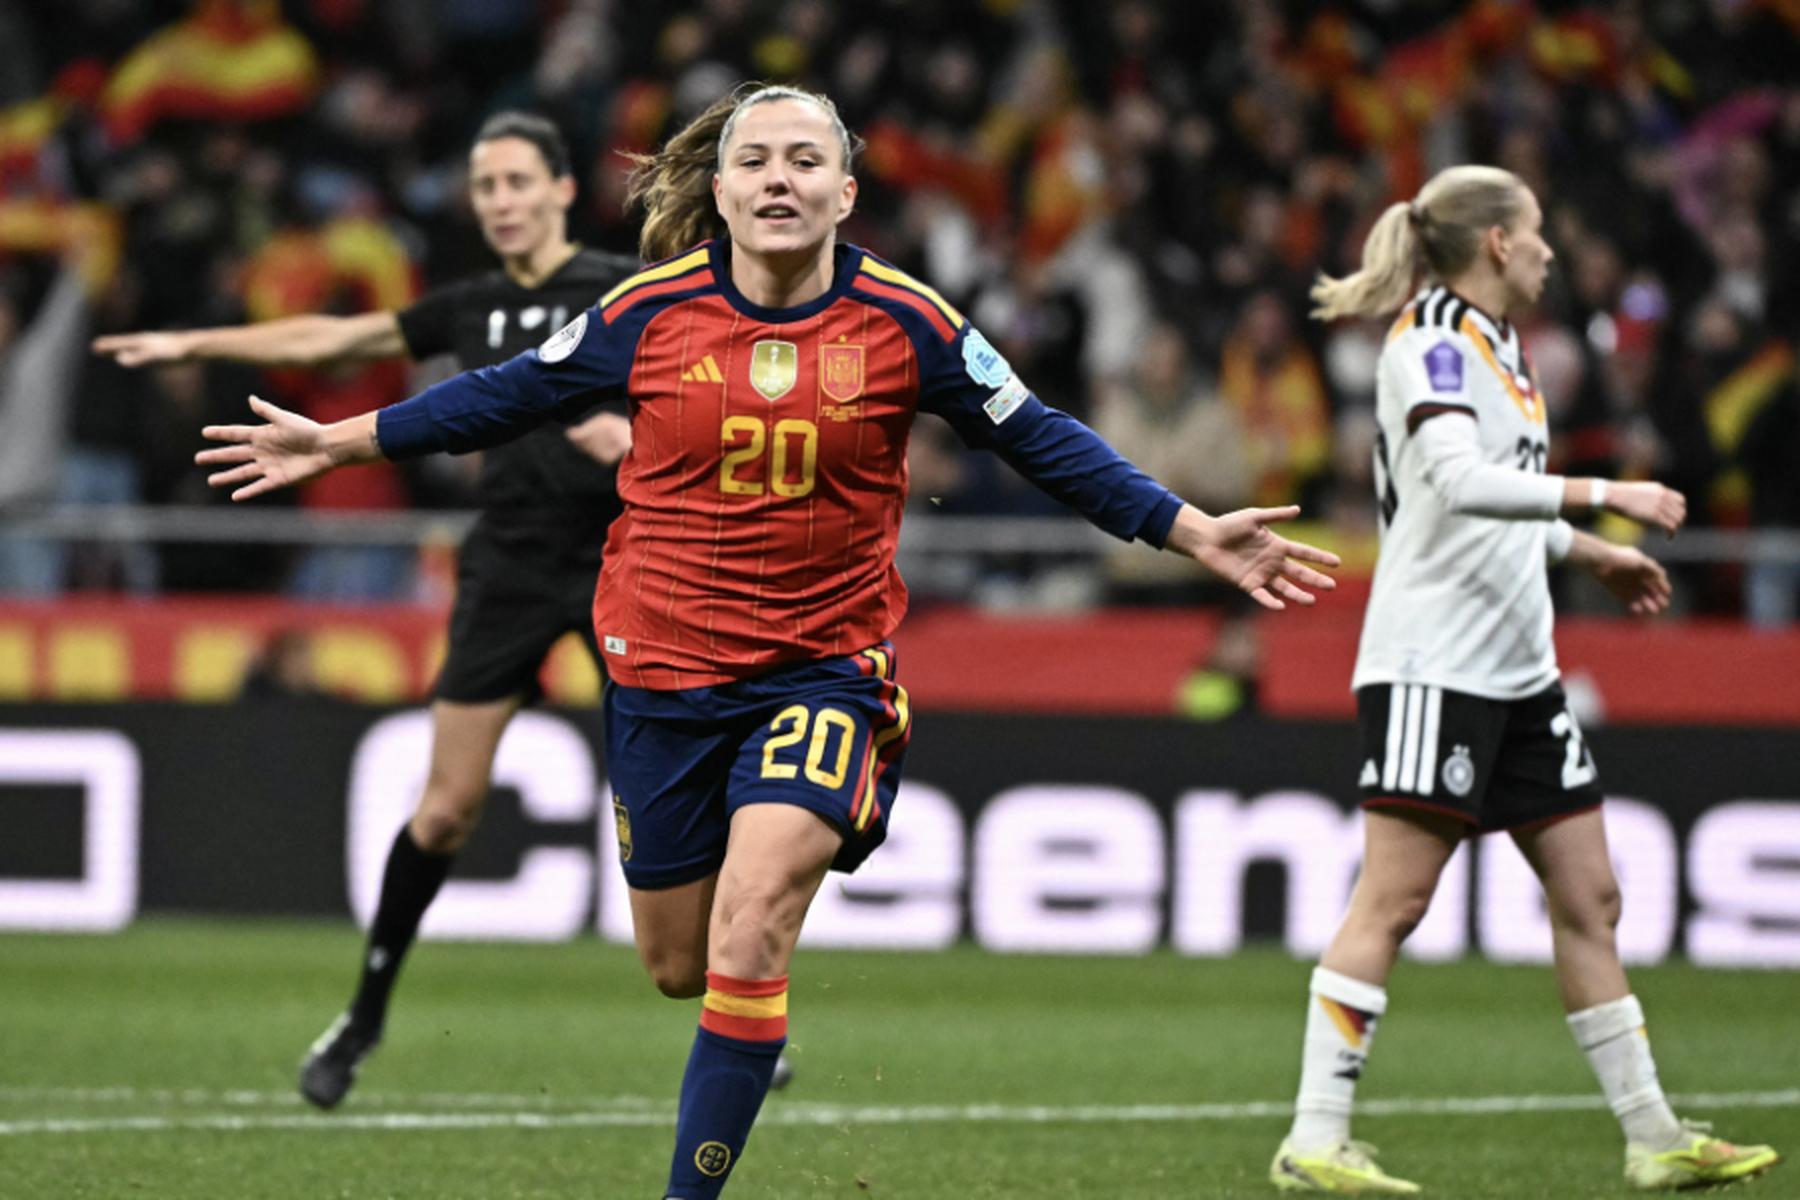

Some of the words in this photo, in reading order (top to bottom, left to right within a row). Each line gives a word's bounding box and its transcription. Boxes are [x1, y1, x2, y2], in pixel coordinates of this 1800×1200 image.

[720, 416, 817, 498] 20
[761, 704, 855, 789] 20
[1550, 711, 1597, 790] 2
